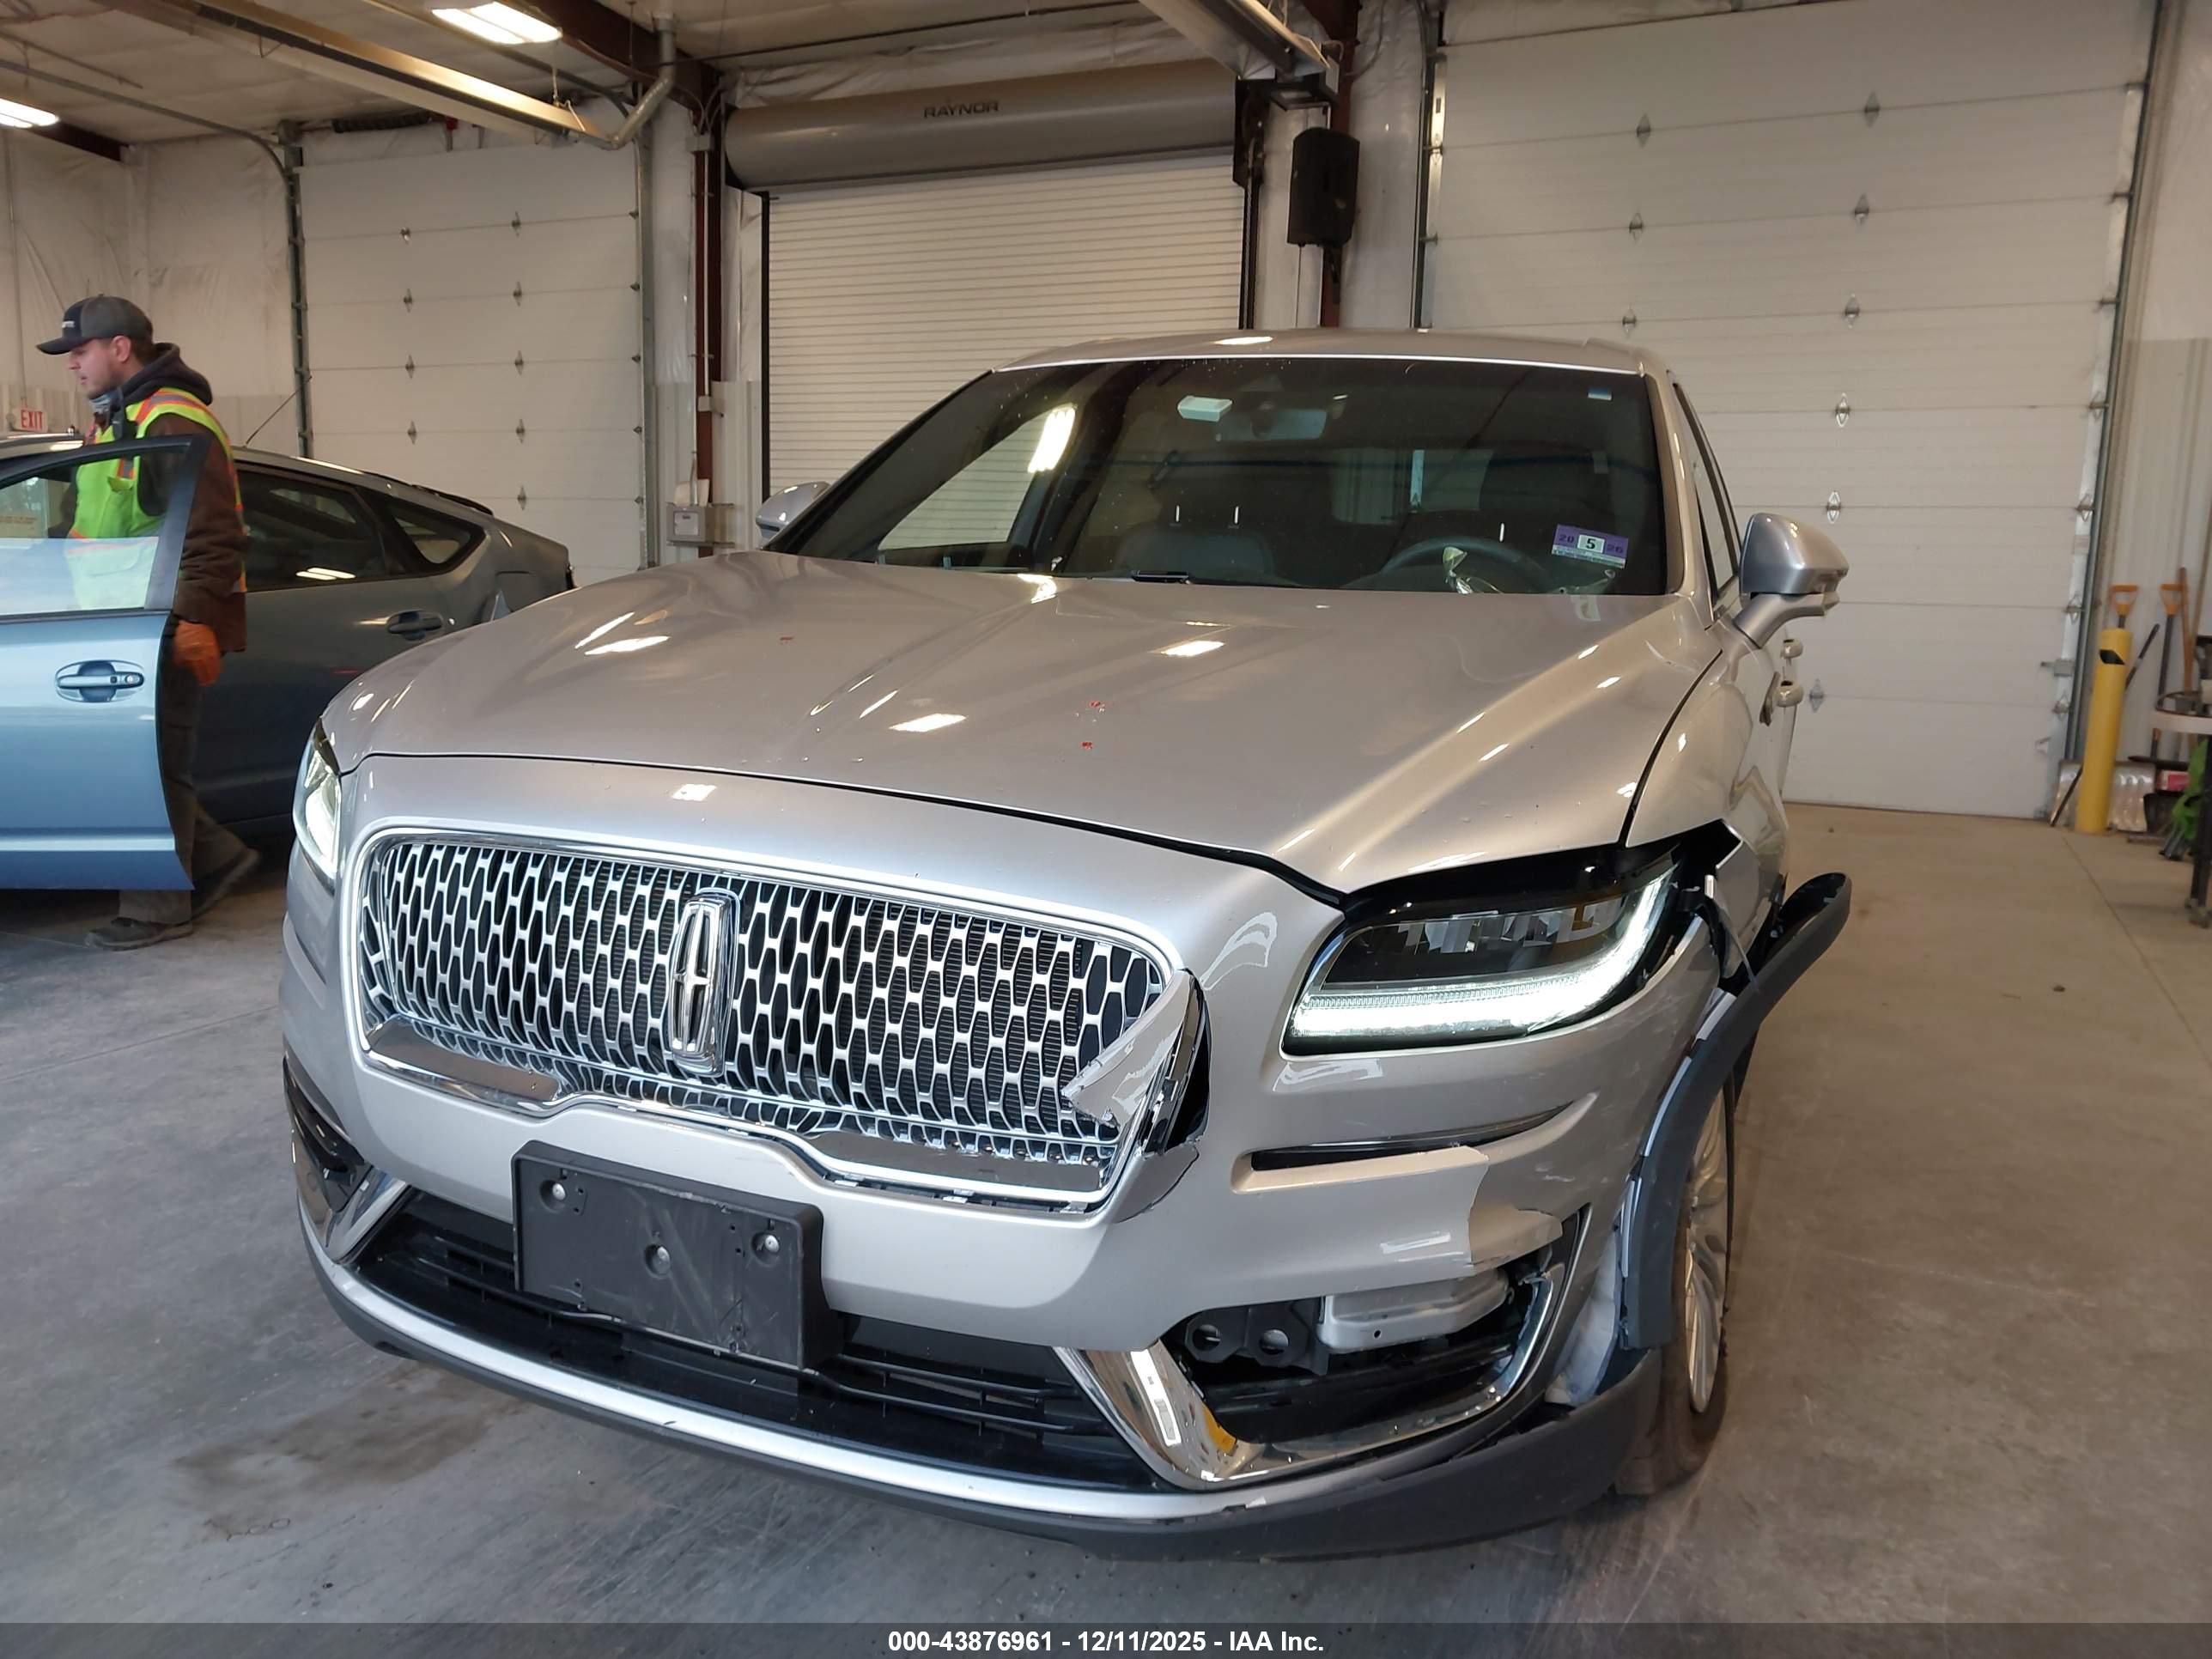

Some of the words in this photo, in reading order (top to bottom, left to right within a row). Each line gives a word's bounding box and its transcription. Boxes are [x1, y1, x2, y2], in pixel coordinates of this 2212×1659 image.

[924, 100, 1000, 118] RAYNOR
[21, 410, 43, 429] EXIT
[1559, 534, 1574, 543] 20
[1586, 538, 1595, 549] 5
